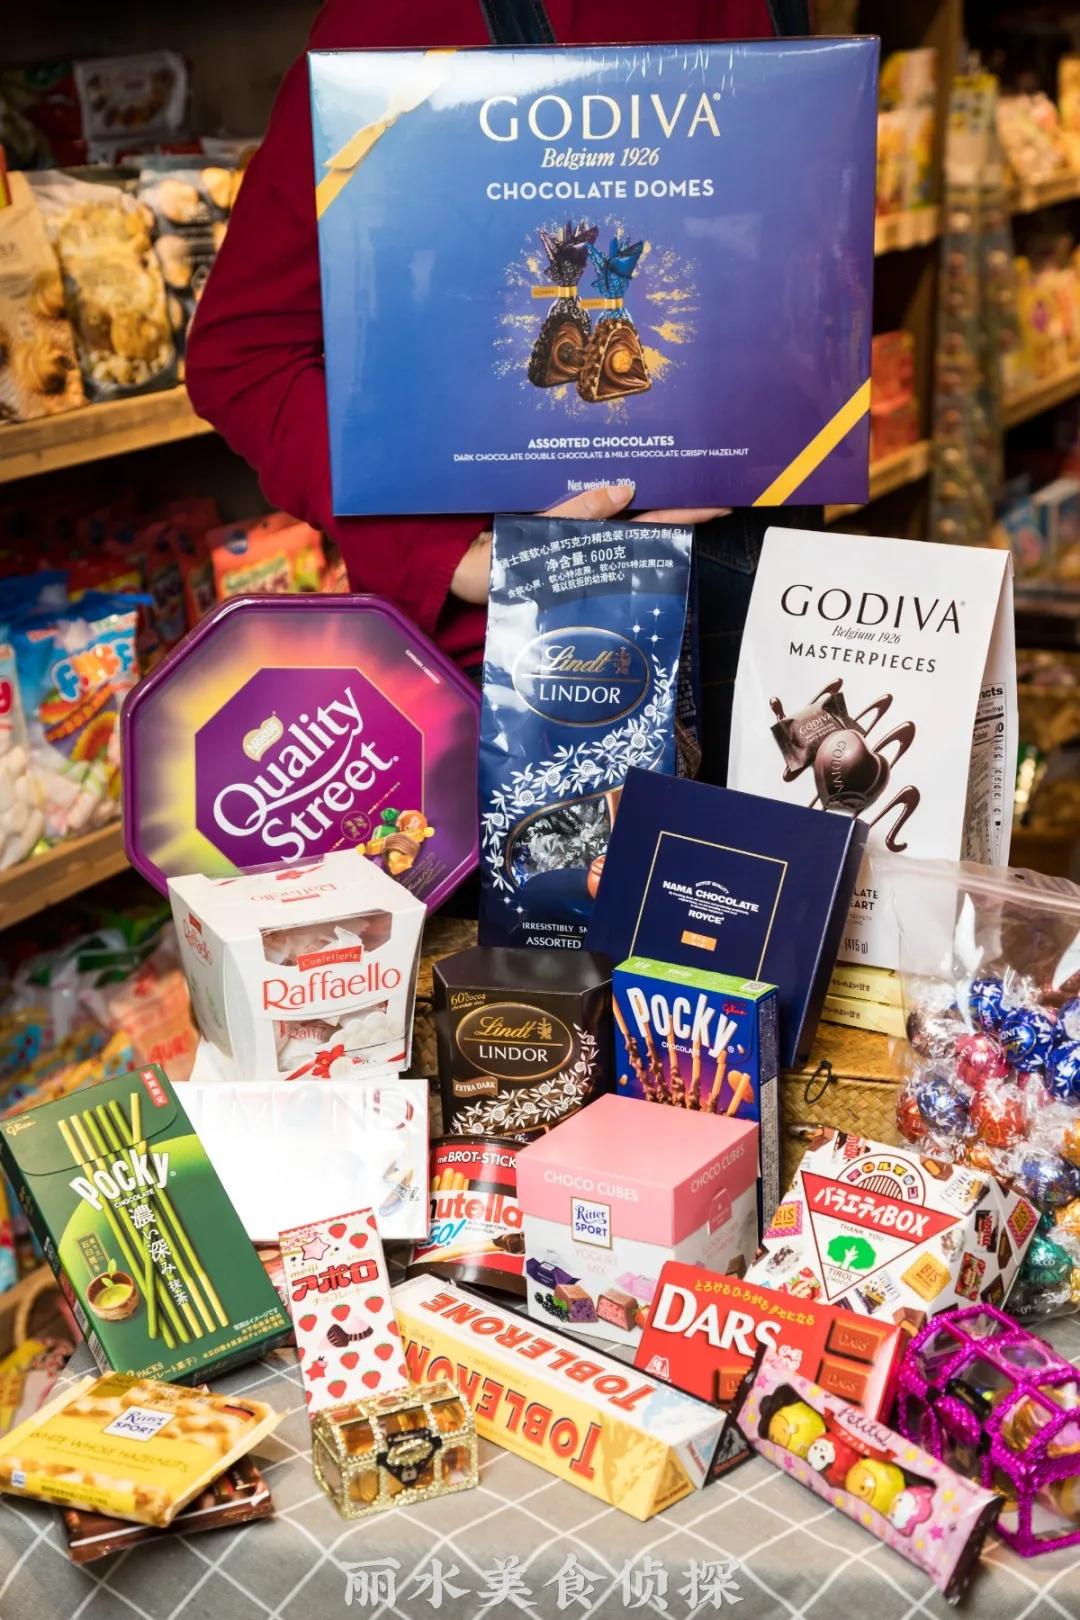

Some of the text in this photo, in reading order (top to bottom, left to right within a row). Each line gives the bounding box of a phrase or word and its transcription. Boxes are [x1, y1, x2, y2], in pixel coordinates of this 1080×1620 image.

[479, 93, 721, 142] GODIVA
[540, 147, 660, 170] Belgium 1926
[486, 178, 715, 201] CHOCOLATE DOMES
[528, 435, 674, 449] ASSORTED CHOCOLATES
[453, 454, 474, 462] DARK
[475, 453, 523, 462] CHOCOLATE
[525, 452, 556, 460] DOUBLE
[557, 451, 603, 460] CHOCOLATE
[605, 451, 610, 459] &
[631, 450, 679, 458] CHOCOLATE
[680, 449, 707, 457] CRISPY
[708, 448, 749, 456] HAZELNUT
[567, 480, 582, 491] Net
[590, 545, 626, 563] 600克
[781, 584, 960, 634] GODIVA
[831, 625, 901, 645] Belgium 1926
[537, 646, 614, 673] Lindt
[789, 641, 936, 673] MASTERPIECES
[539, 683, 621, 704] LINDOR
[979, 685, 1004, 701] acts
[213, 686, 363, 837] Quality
[261, 741, 396, 863] Street
[662, 881, 692, 895] NAMA
[695, 889, 759, 912] CHOCOLATE
[522, 922, 574, 933] IRRESISTIBLY
[526, 937, 582, 949] ASSORTED
[263, 961, 401, 1010] Raffaello
[474, 1017, 537, 1039] Lindt
[479, 1045, 548, 1062] LINDOR
[455, 1081, 496, 1093] EXTRA DARK
[691, 1143, 745, 1194] CHOCO CUBES
[544, 1169, 639, 1203] CHOCO CUBES
[113, 1189, 155, 1208] CHOCOLATE
[574, 1204, 607, 1225] Ritter
[814, 1187, 930, 1237] バラエティBOX
[575, 1222, 608, 1238] SPORT
[840, 1223, 884, 1241] THANK YOU
[292, 1259, 379, 1302] アポロ
[828, 1268, 853, 1282] TIROL
[652, 1283, 782, 1357] DARS
[420, 1293, 656, 1411] TOBLERONE
[402, 1336, 602, 1480] TOBLERON
[115, 1421, 155, 1434] SPORT
